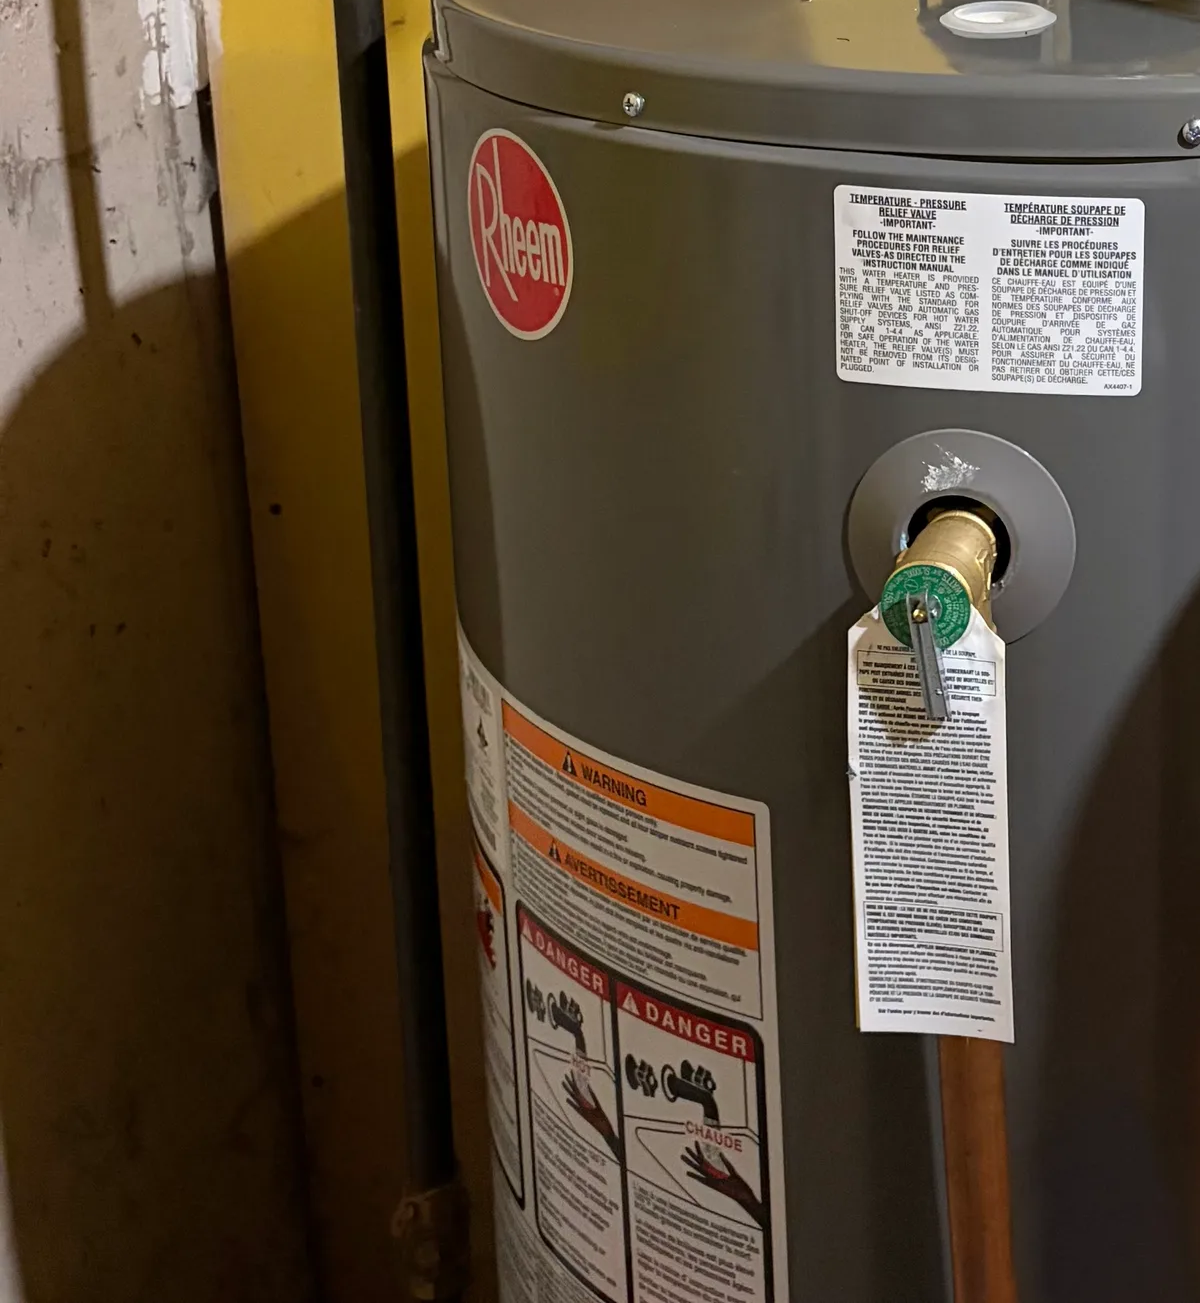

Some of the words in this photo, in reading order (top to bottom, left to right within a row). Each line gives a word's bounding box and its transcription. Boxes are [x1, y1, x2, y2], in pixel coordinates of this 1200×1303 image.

[850, 193, 912, 207] TEMPERATURE
[920, 198, 966, 210] PRESSURE
[1004, 203, 1068, 214] TEMPÉRATURE
[1071, 205, 1112, 215] SOUPAPE
[1114, 206, 1126, 215] DE
[475, 137, 566, 302] Rheem
[879, 207, 908, 218] RELIEF
[910, 209, 937, 220] VALVE
[1011, 214, 1058, 225] DÉCHARGE
[1061, 216, 1072, 225] DE
[1075, 217, 1119, 226] PRESSION
[880, 218, 936, 230] -IMPORTANT-
[1036, 227, 1093, 236] -IMPORTANT-
[853, 229, 886, 241] FOLLOW
[888, 232, 904, 242] THE
[906, 234, 964, 245] MAINTENANCE
[1011, 239, 1042, 249] SUIVRE
[1044, 241, 1059, 249] LES
[1062, 241, 1118, 251] PROCÉDURES
[857, 239, 911, 252] PROCEDURES
[913, 244, 930, 253] FOR
[932, 245, 960, 255] RELIEF
[993, 248, 1046, 258] D'ENTRETIEN
[1049, 250, 1072, 259] POUR
[1075, 251, 1090, 260] LES
[1093, 251, 1136, 260] SOUPAPES
[852, 248, 895, 260] VALVES-AS
[897, 252, 937, 263] DIRECTED
[939, 255, 948, 263] IN
[950, 255, 965, 264] THE
[1000, 258, 1011, 267] DE
[1013, 258, 1058, 268] DÉCHARGE
[1060, 260, 1092, 269] COMME
[1095, 261, 1129, 270] INDIQUÉ
[863, 259, 917, 271] INSTRUCTION
[920, 263, 954, 273] MANUAL
[997, 267, 1020, 276] DANS
[1022, 268, 1032, 277] LE
[1035, 269, 1069, 278] MANUEL
[1072, 270, 1132, 279] D'UTILISATION
[839, 275, 857, 284] WITH
[864, 277, 870, 285] A
[877, 278, 927, 289] TEMPERATURE
[935, 282, 950, 291] AND
[958, 284, 979, 292] PRES-
[840, 267, 855, 276] THIS
[862, 269, 886, 278] WATER
[894, 271, 920, 281] HEATER
[928, 274, 935, 282] IS
[943, 275, 979, 284] PROVIDED
[839, 283, 858, 292] SURE
[862, 285, 885, 294] RELIEF
[890, 288, 911, 296] VALVE
[916, 289, 941, 298] LISTED
[946, 291, 955, 299] AS
[960, 292, 979, 300] COM-
[840, 291, 864, 300] PLYING
[872, 294, 890, 303] WITH
[898, 296, 911, 304] THE
[919, 298, 957, 307] STANDARD
[965, 300, 979, 308] FOR
[581, 764, 647, 807] WARNING
[564, 853, 680, 920] AVERTISSEMENT
[535, 932, 604, 995] DANGER
[645, 1002, 748, 1057] DANGER
[685, 1120, 743, 1153] CHAUDE
